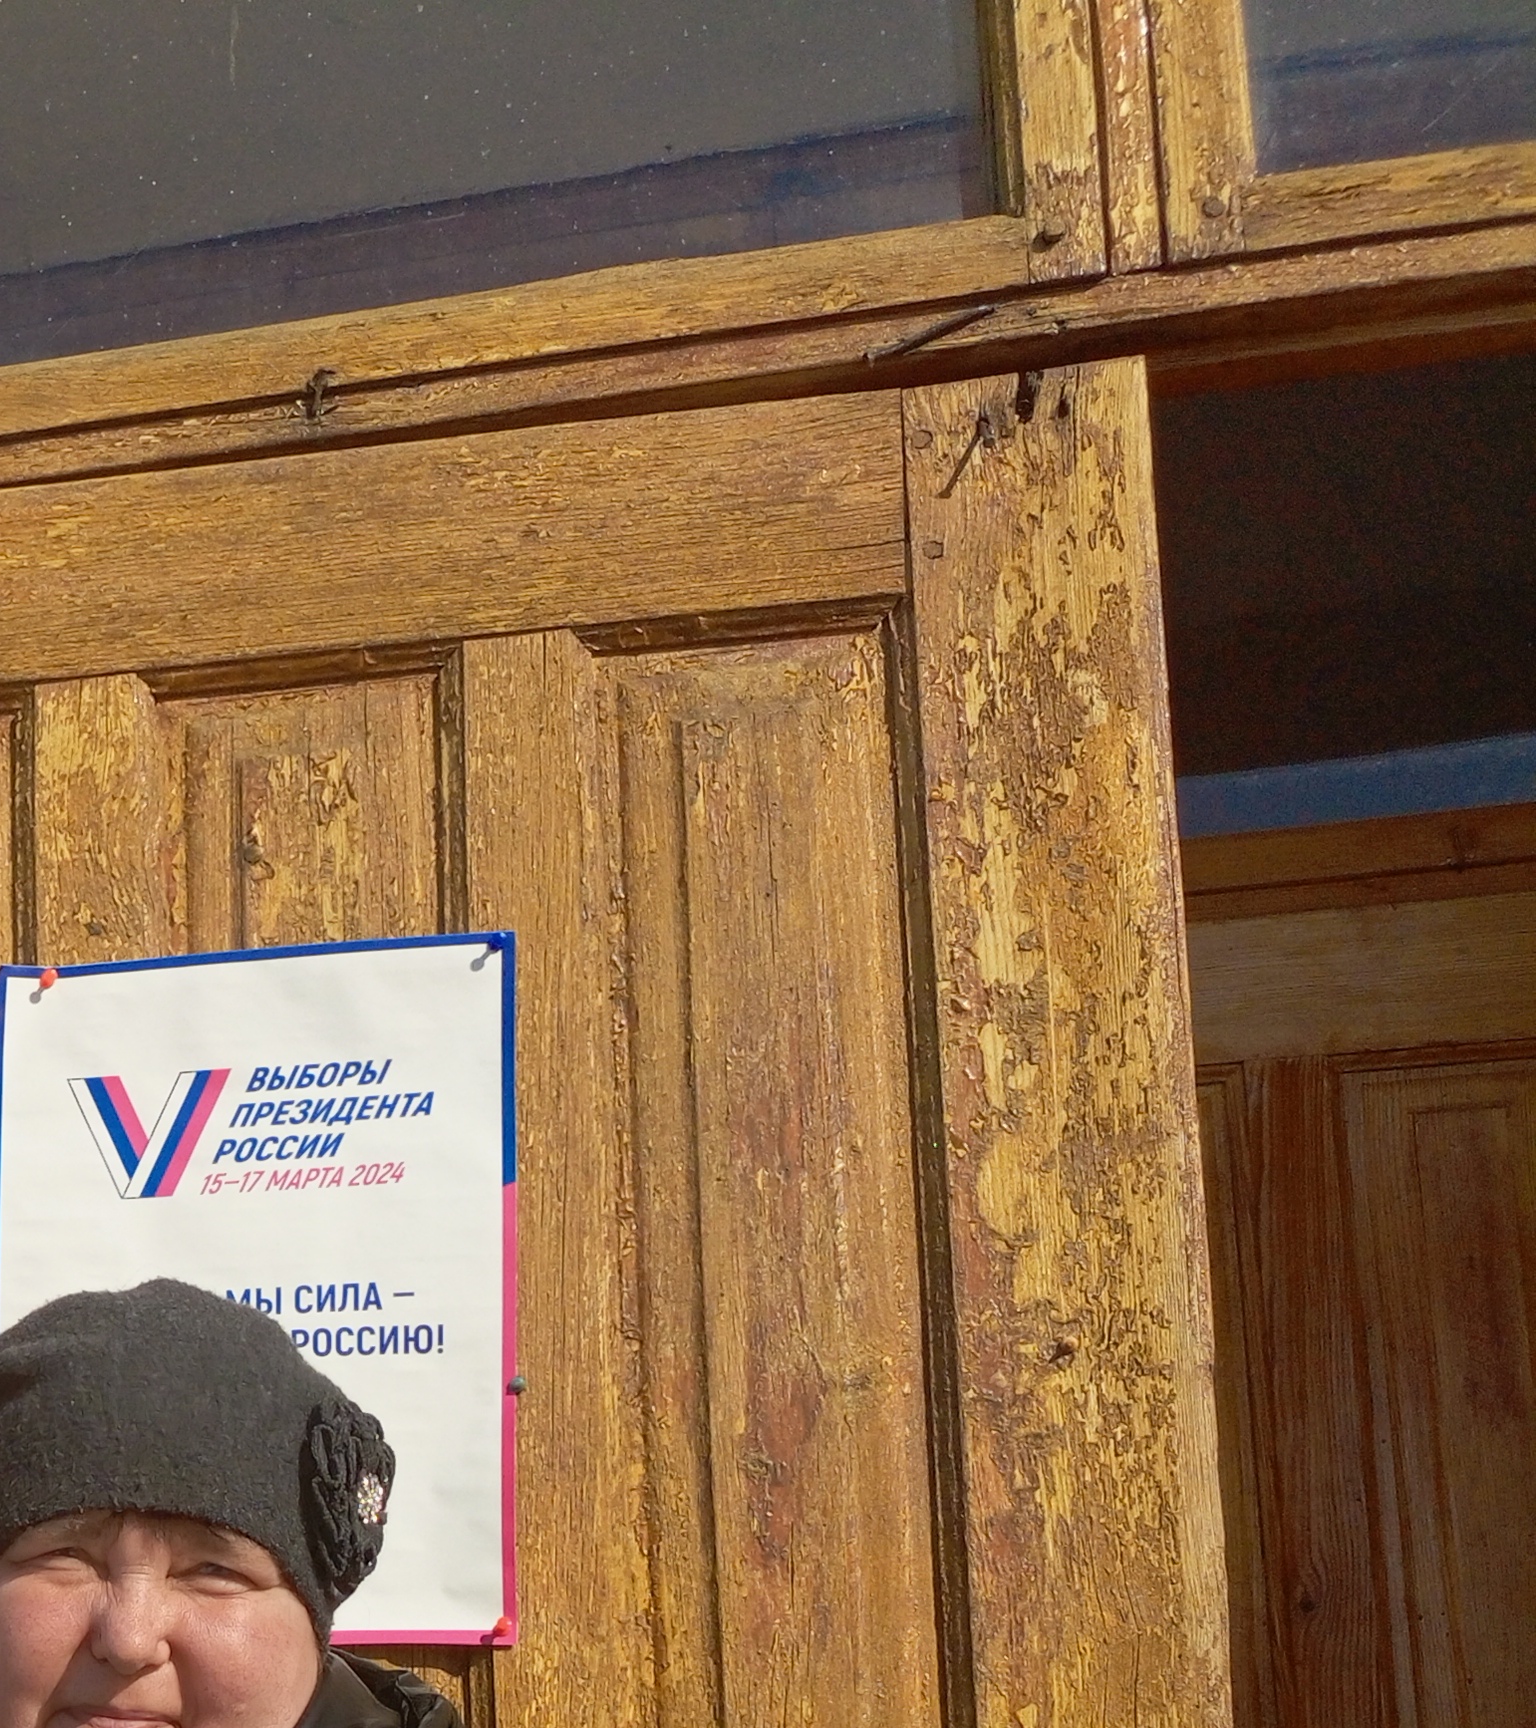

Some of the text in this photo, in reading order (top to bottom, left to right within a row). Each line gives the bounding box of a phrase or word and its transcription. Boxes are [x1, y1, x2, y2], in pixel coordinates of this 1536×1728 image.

[244, 1058, 394, 1094] ВЫБОРЫ
[228, 1090, 435, 1129] ПРЕЗИДЕНТА
[212, 1132, 346, 1165] РОССИИ
[266, 1166, 343, 1194] МАРТА
[347, 1161, 407, 1188] 2024
[294, 1281, 383, 1314] СИЛА
[291, 1323, 445, 1357] РОССИЮ!
